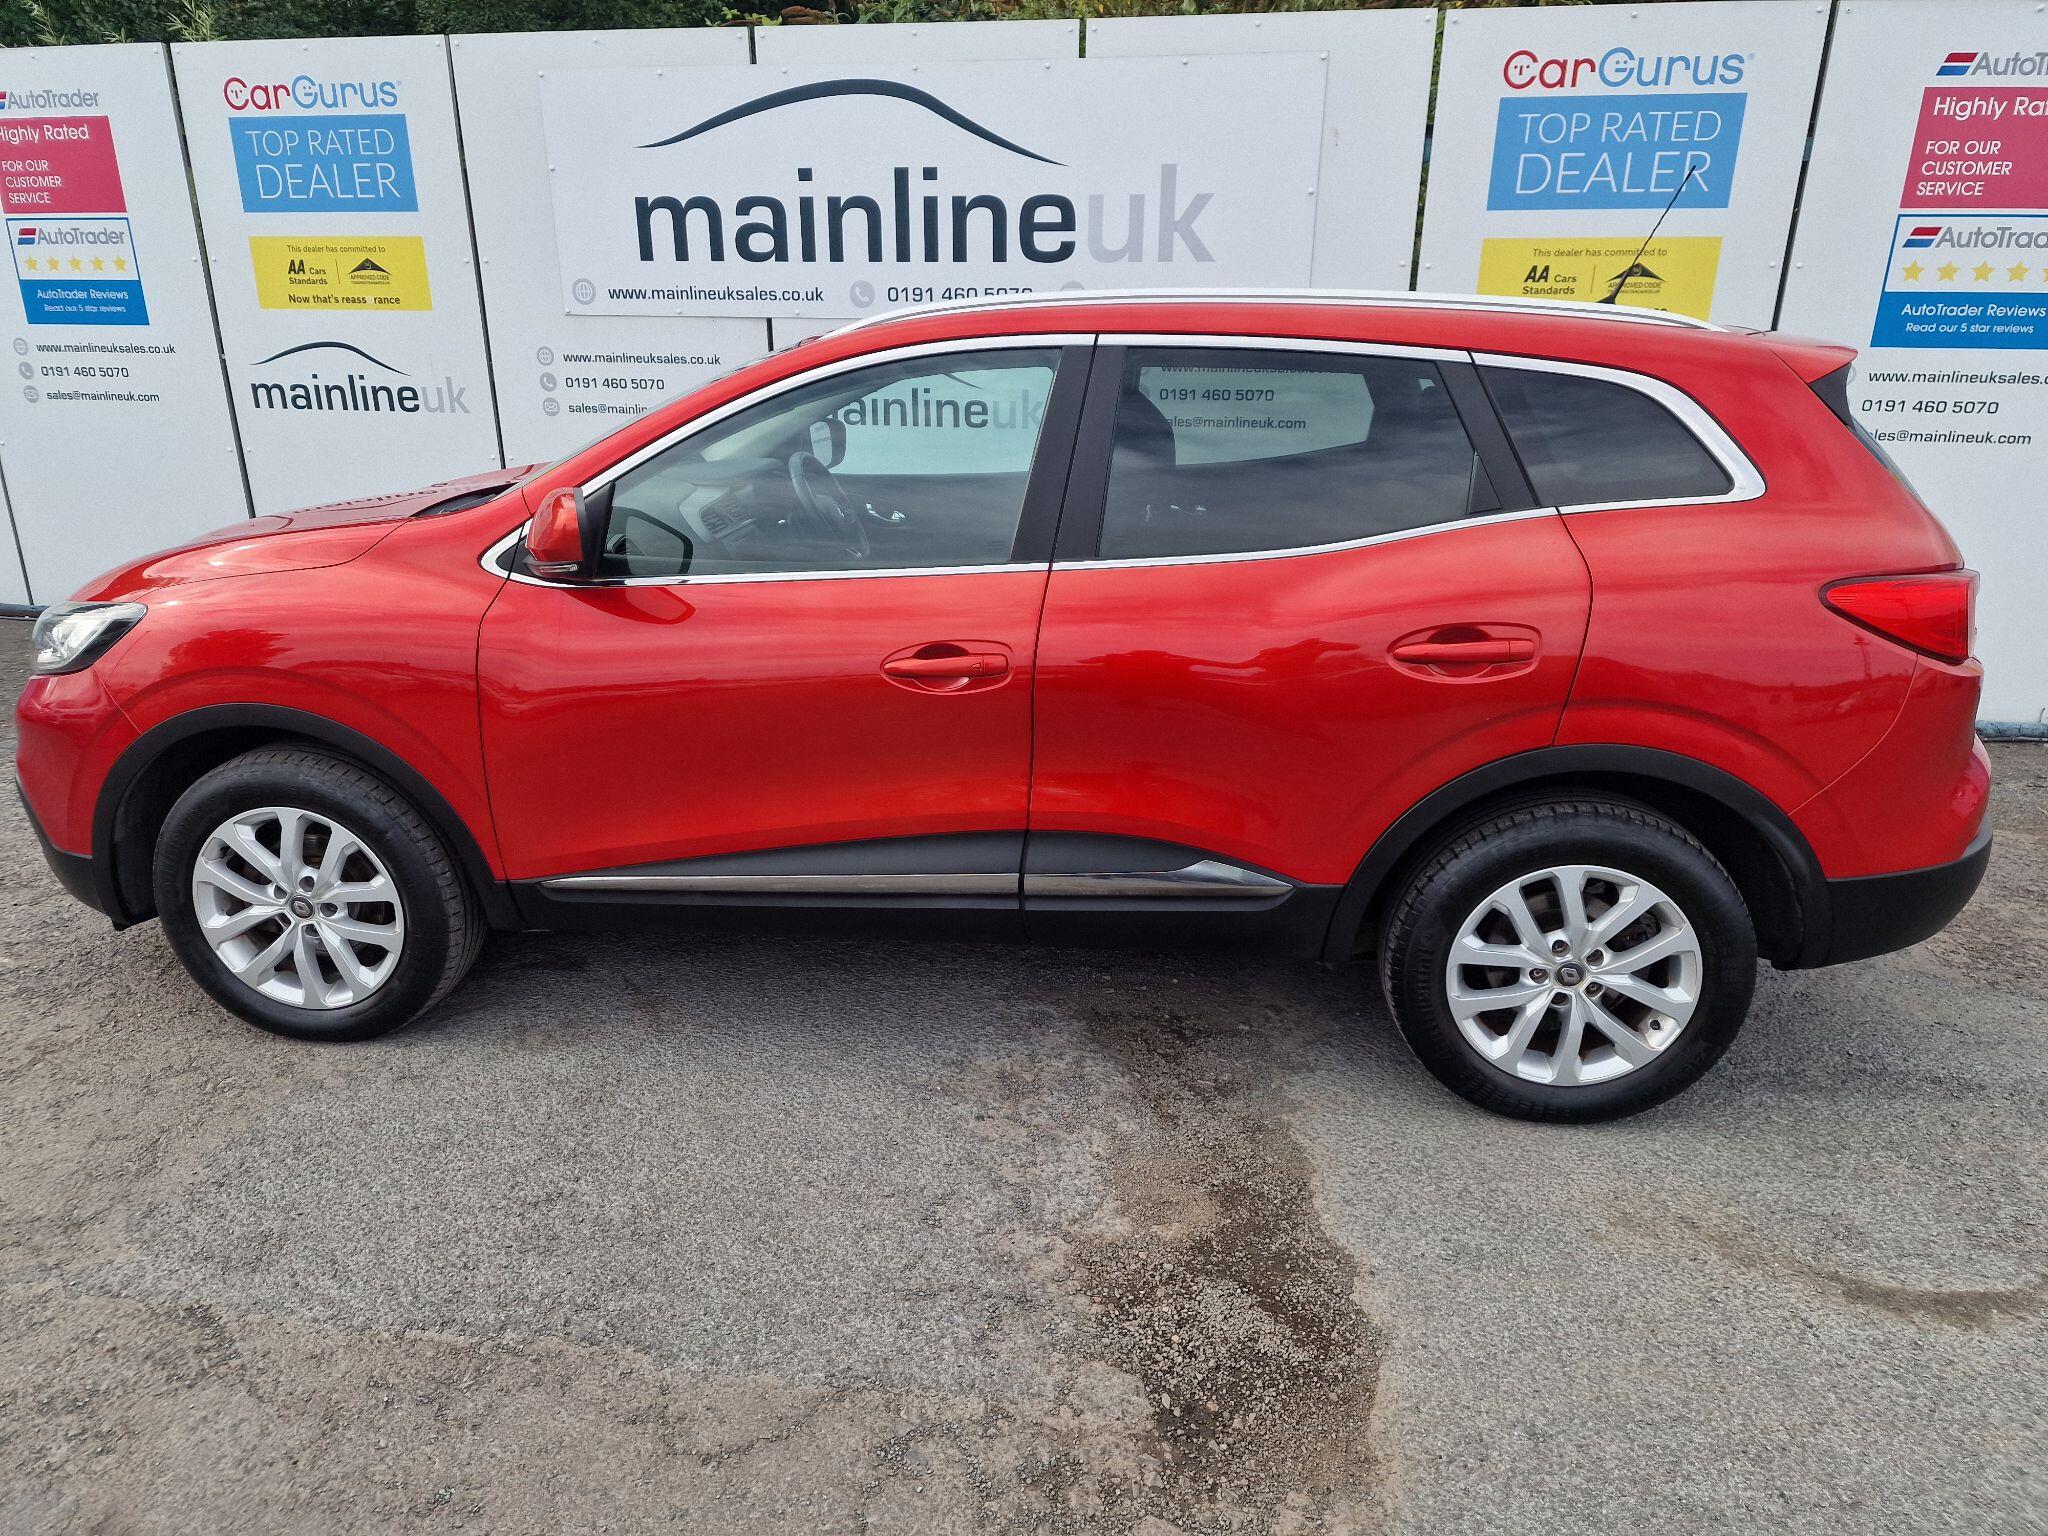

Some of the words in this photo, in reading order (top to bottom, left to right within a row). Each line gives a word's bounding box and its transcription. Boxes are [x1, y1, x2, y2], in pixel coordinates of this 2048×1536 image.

[1503, 47, 1745, 89] CarGurus
[1970, 51, 2048, 76] AutoT
[7, 88, 99, 109] AutoTrader
[223, 75, 399, 111] CarGurus
[1932, 96, 2008, 121] Highly
[43, 123, 89, 140] Rated
[1518, 112, 1591, 144] TOP
[1601, 110, 1722, 142] RATED
[245, 129, 299, 157] TOP
[307, 128, 395, 155] RATED
[1925, 140, 1960, 155] FOR
[1964, 140, 2001, 155] OUR
[2, 160, 23, 172] FOR
[25, 159, 49, 171] OUR
[1515, 150, 1711, 194] DEALER
[1921, 160, 2013, 176] CUSTOMER
[5, 175, 62, 188] CUSTOMER
[256, 162, 400, 199] DEALER
[1916, 181, 1985, 196] SERVICE
[8, 192, 52, 204] SERVICE
[634, 163, 1216, 264] mainlineuk
[37, 227, 125, 245] AutoTrader
[287, 245, 301, 253] This
[303, 244, 324, 253] dealer
[326, 245, 338, 253] has
[340, 245, 377, 253] committed
[378, 245, 386, 253] to
[1533, 247, 1552, 257] This
[1554, 247, 1583, 257] dealer
[1585, 247, 1602, 257] has
[1604, 247, 1655, 257] commited
[1657, 247, 1668, 257] to
[288, 259, 306, 275] AA
[309, 267, 327, 275] Cars
[1524, 264, 1550, 283] AA
[1554, 273, 1577, 283] Cars
[288, 277, 328, 285] Standards
[37, 288, 87, 300] AutoTrader
[89, 288, 129, 300] Reviews
[607, 286, 824, 301] www.mainlineuksales.co.uk
[887, 287, 934, 303] 0191
[1522, 286, 1576, 295] Standards
[288, 294, 310, 304] Now
[312, 294, 339, 304] that's
[79, 304, 84, 312] 5
[99, 304, 127, 313] reviews
[1901, 303, 1984, 317] AutoTrader
[1987, 303, 2047, 317] Reviews
[1905, 322, 1937, 333] Read
[1939, 324, 1958, 333] our
[1960, 323, 1968, 332] 5
[1969, 323, 1991, 333] star
[1992, 323, 2035, 334] reviews
[36, 342, 176, 354] www.mainlineuksales.co.uk
[562, 351, 721, 365] www.mainlineuksales.co.uk
[41, 366, 69, 377] 0191
[74, 366, 96, 377] 460
[99, 367, 129, 378] 5070
[565, 376, 598, 389] 0191
[602, 377, 628, 389] 460
[631, 377, 665, 390] 5070
[46, 388, 160, 402] sales@mainlineuk.com
[251, 373, 472, 414] mainlineuk
[1159, 388, 1196, 400] 0191
[1201, 388, 1231, 401] 460
[1235, 389, 1275, 401] 5070
[832, 387, 1042, 429] ainlineuk
[1861, 399, 1907, 412] 0191
[1911, 400, 1948, 413] 460
[1951, 401, 2000, 414] 5070
[1870, 429, 2032, 445] les@mainlineuk.com
